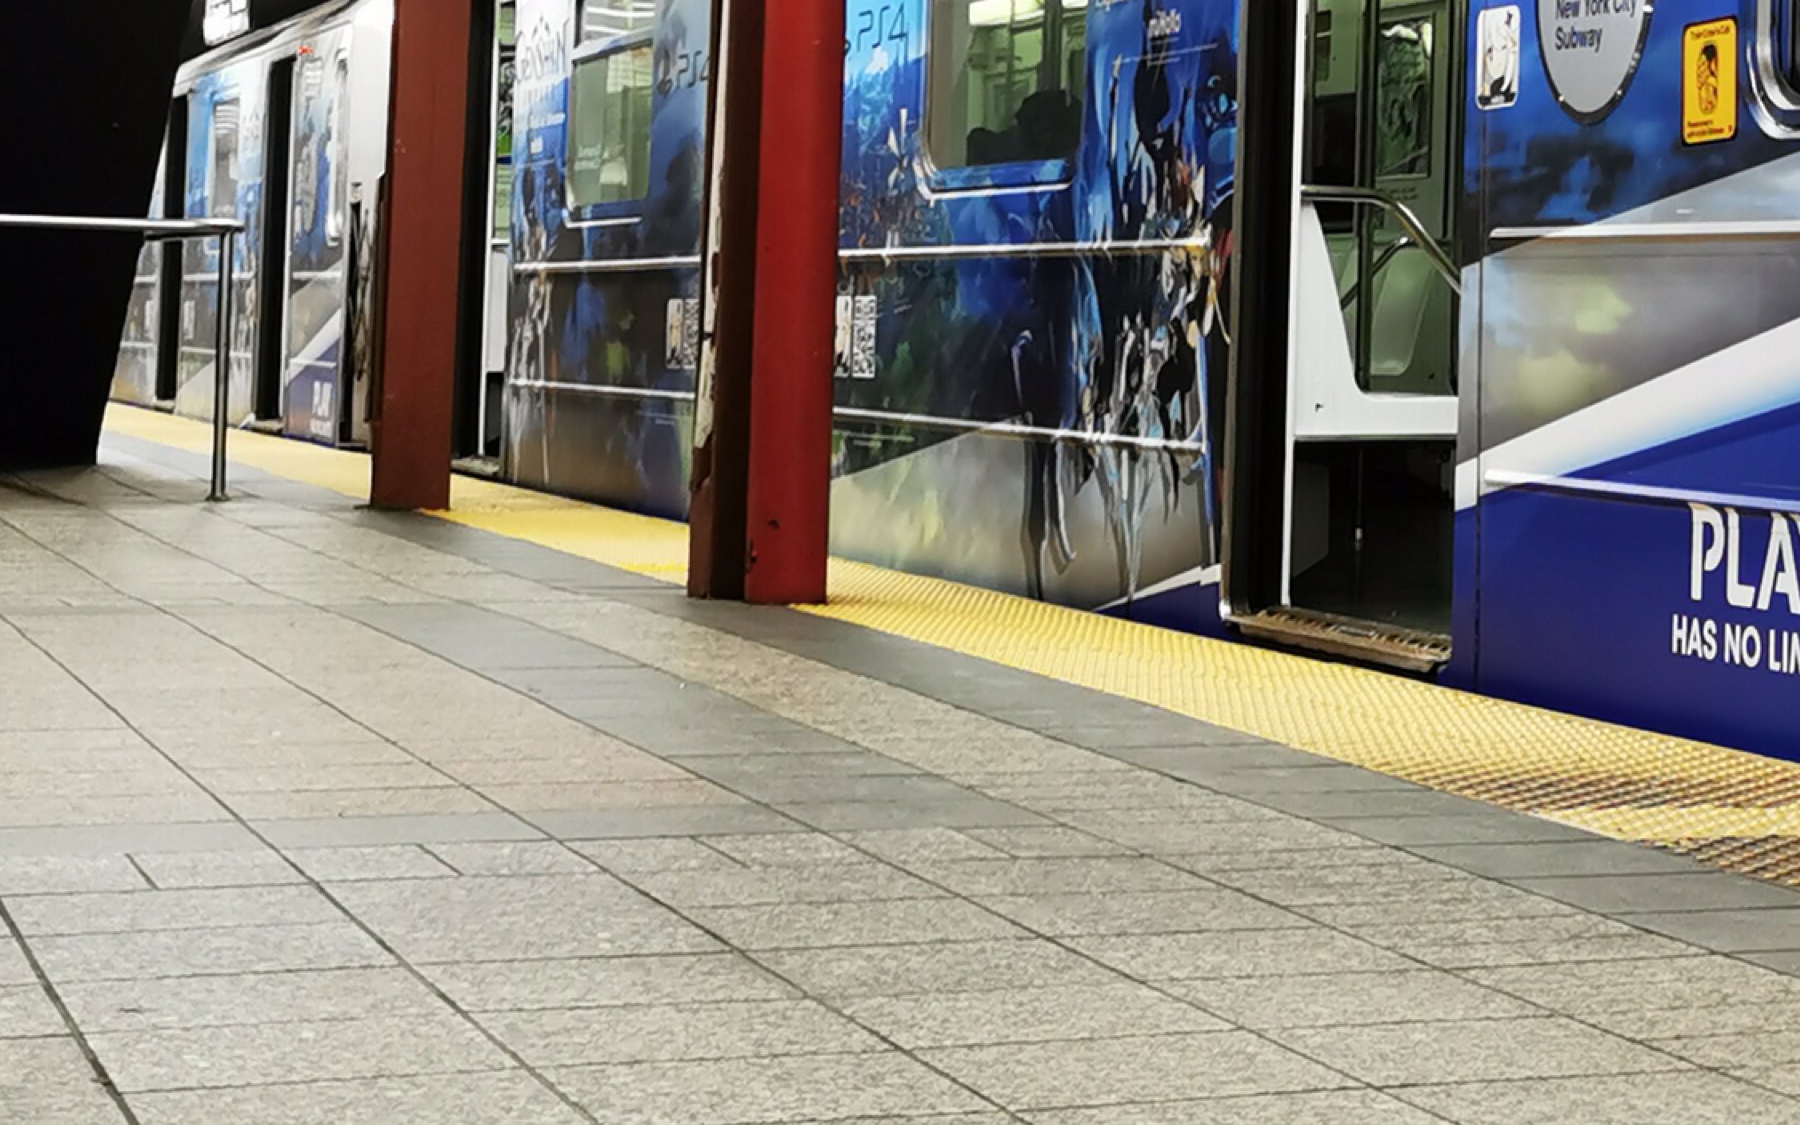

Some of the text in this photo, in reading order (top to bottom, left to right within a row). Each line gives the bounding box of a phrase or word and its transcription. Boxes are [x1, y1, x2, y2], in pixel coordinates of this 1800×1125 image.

[857, 2, 909, 52] PS4
[1554, 25, 1603, 53] Subway
[1671, 613, 1718, 662] HAS
[1724, 622, 1762, 668] NO
